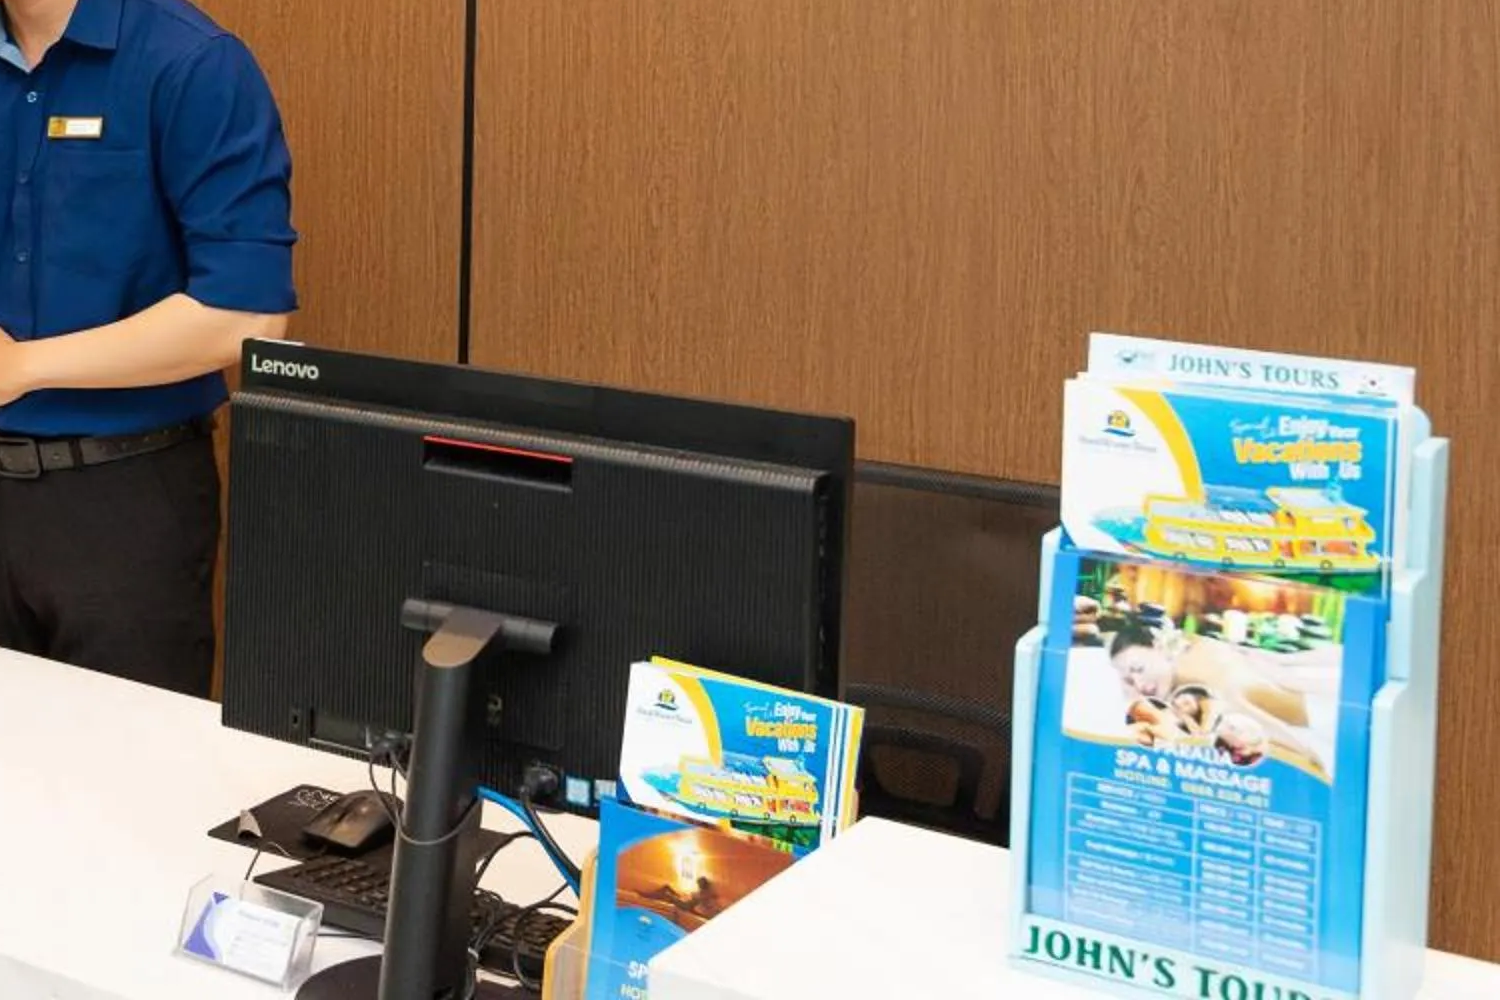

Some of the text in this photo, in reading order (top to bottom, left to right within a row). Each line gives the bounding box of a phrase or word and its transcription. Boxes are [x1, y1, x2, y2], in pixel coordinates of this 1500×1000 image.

[251, 353, 319, 379] Lenovo
[1168, 353, 1341, 389] JOHN'S TOURS
[1232, 436, 1362, 464] Vacations
[745, 715, 817, 741] Vacations
[1115, 749, 1152, 771] SPA
[1156, 757, 1171, 775] &
[1174, 759, 1272, 795] MASSAGE
[1023, 925, 1332, 1000] JOHN'S TOU
